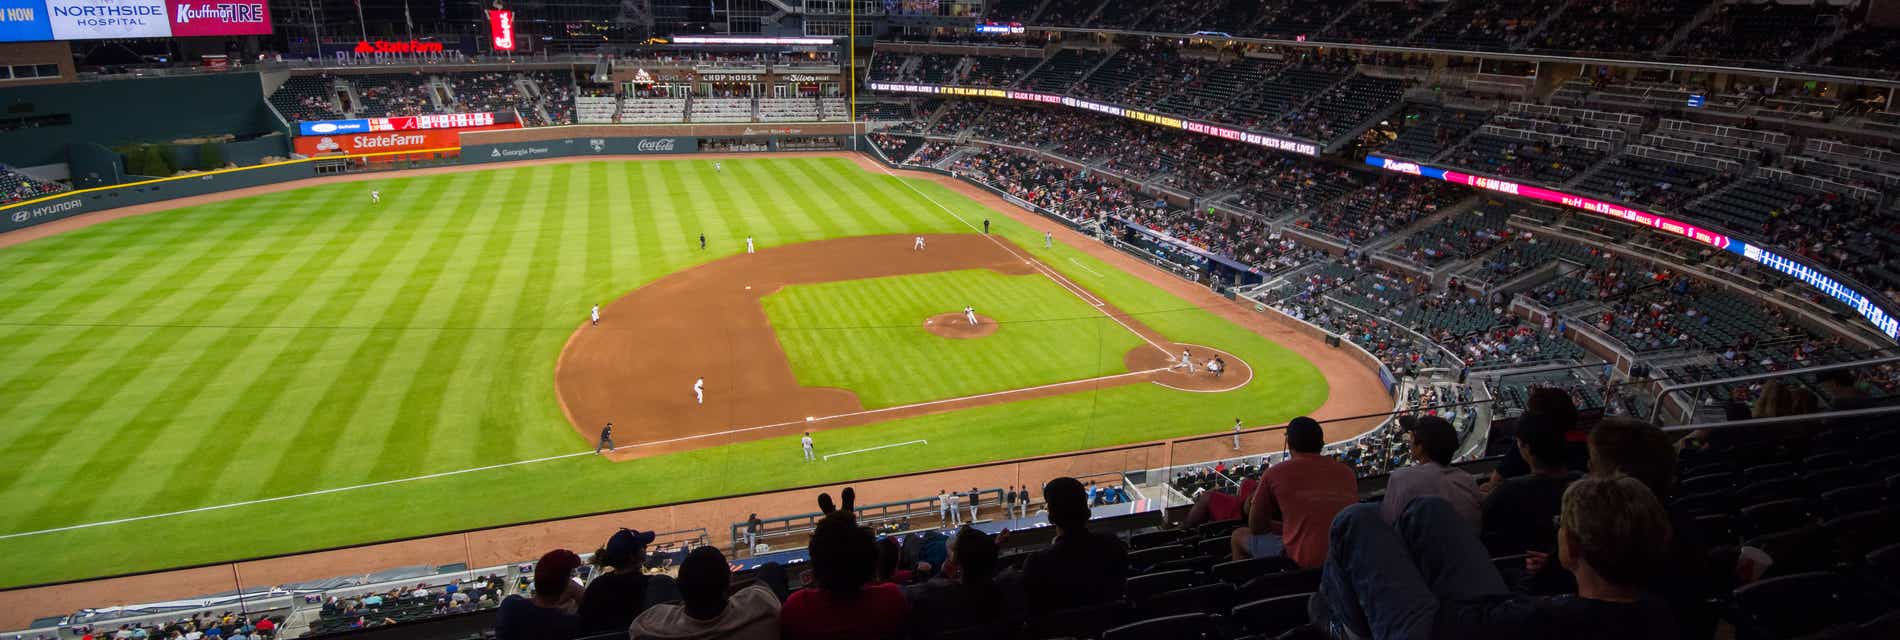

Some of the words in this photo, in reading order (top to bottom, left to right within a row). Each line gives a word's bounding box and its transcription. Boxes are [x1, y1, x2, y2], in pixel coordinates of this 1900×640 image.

[7, 8, 34, 22] HOW
[54, 6, 162, 16] NORTHSIDE
[176, 4, 233, 23] Kauffman
[217, 3, 263, 23] TIRE
[77, 18, 146, 26] HOSPITAL
[336, 50, 369, 65] PLAY
[906, 84, 918, 92] SAVE
[918, 85, 932, 93] LIVES
[941, 86, 947, 94] IT
[954, 87, 965, 95] THE
[1014, 92, 1028, 100] CLICK
[1125, 109, 1131, 118] IT
[1130, 110, 1136, 119] IS
[1136, 111, 1145, 121] THE
[1145, 113, 1155, 123] LAW
[1155, 115, 1161, 124] IN
[1188, 122, 1203, 132] CLICK
[1204, 125, 1210, 134] IT
[1210, 126, 1218, 135] OR
[1247, 134, 1261, 144] SEAT
[1261, 137, 1279, 148] BELTS
[1280, 140, 1296, 151] SAVE
[1296, 143, 1315, 155] LIVES
[502, 148, 528, 157] Georgia
[1486, 179, 1499, 190] IAN
[1499, 181, 1519, 195] KROL
[33, 200, 82, 217] HYUNDAI
[1654, 218, 1661, 228] 4
[1687, 227, 1694, 237] 5
